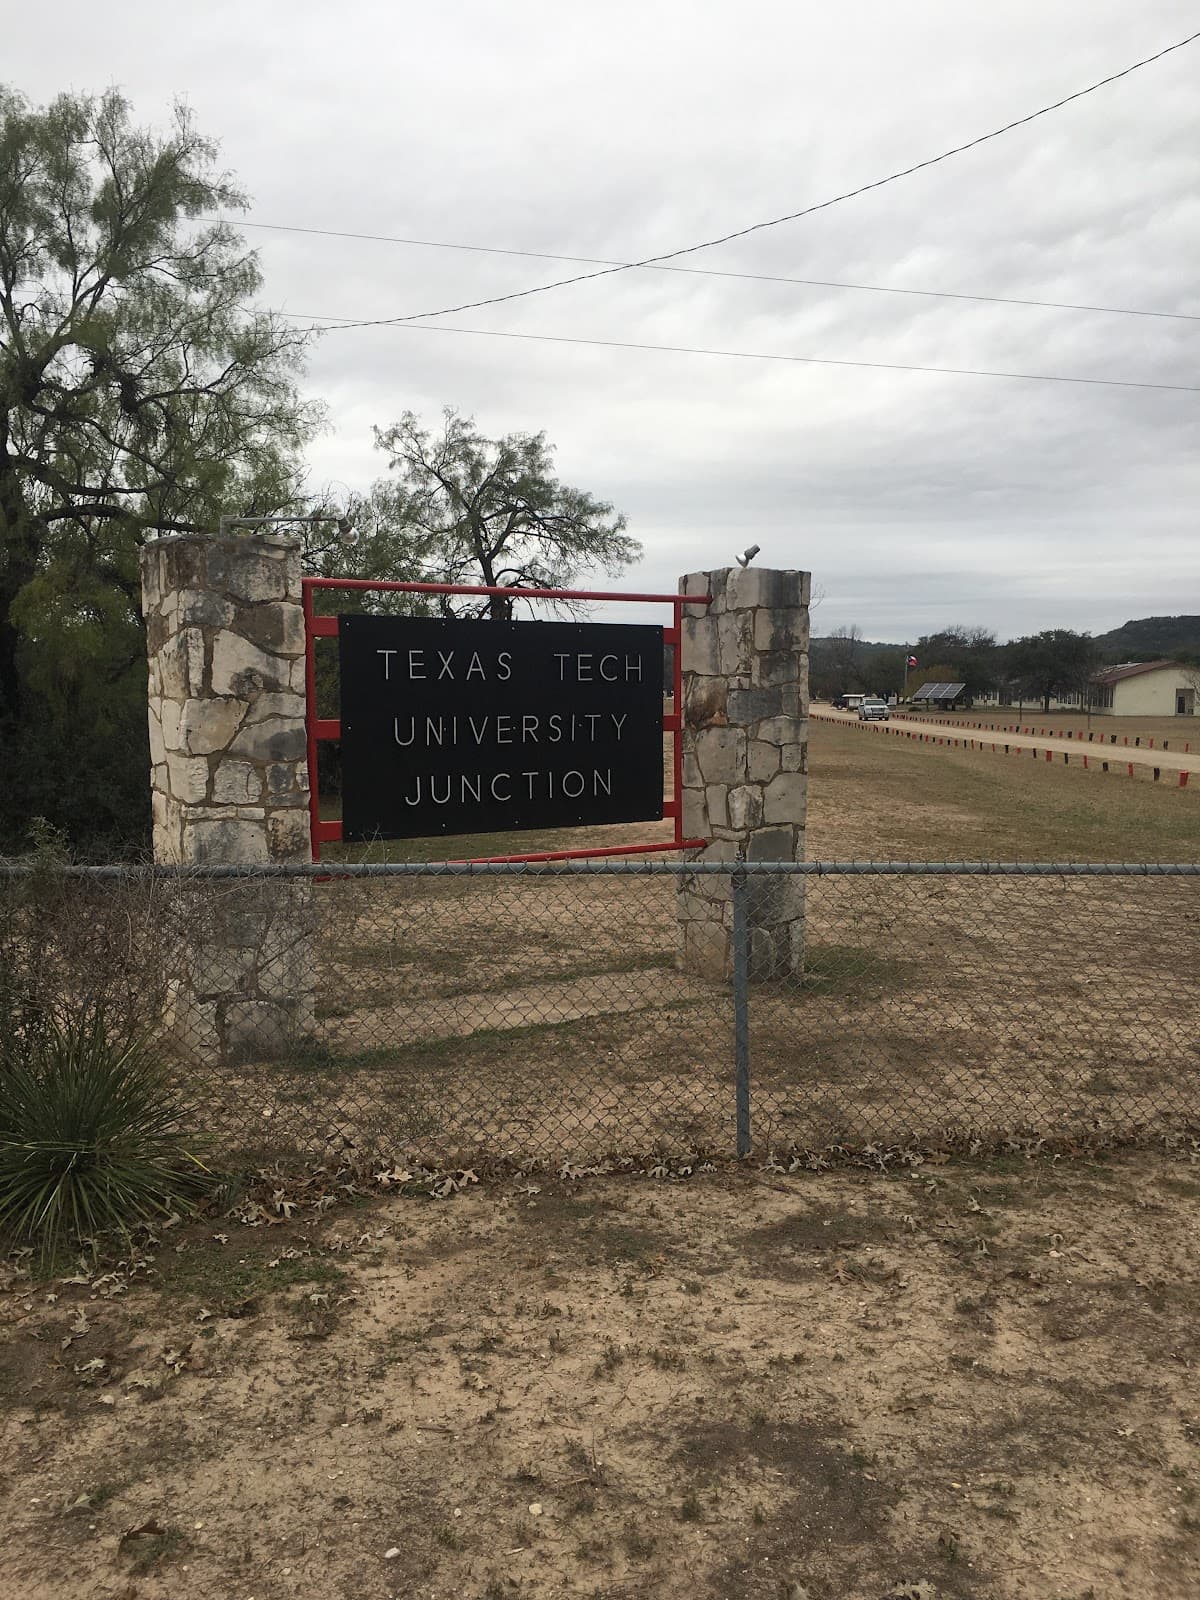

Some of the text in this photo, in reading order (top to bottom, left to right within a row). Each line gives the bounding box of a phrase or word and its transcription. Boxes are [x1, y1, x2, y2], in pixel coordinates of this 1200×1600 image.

[376, 649, 643, 682] TEXAS TECH
[393, 713, 628, 746] UNIVERSITY
[404, 768, 612, 806] JUNCTION
